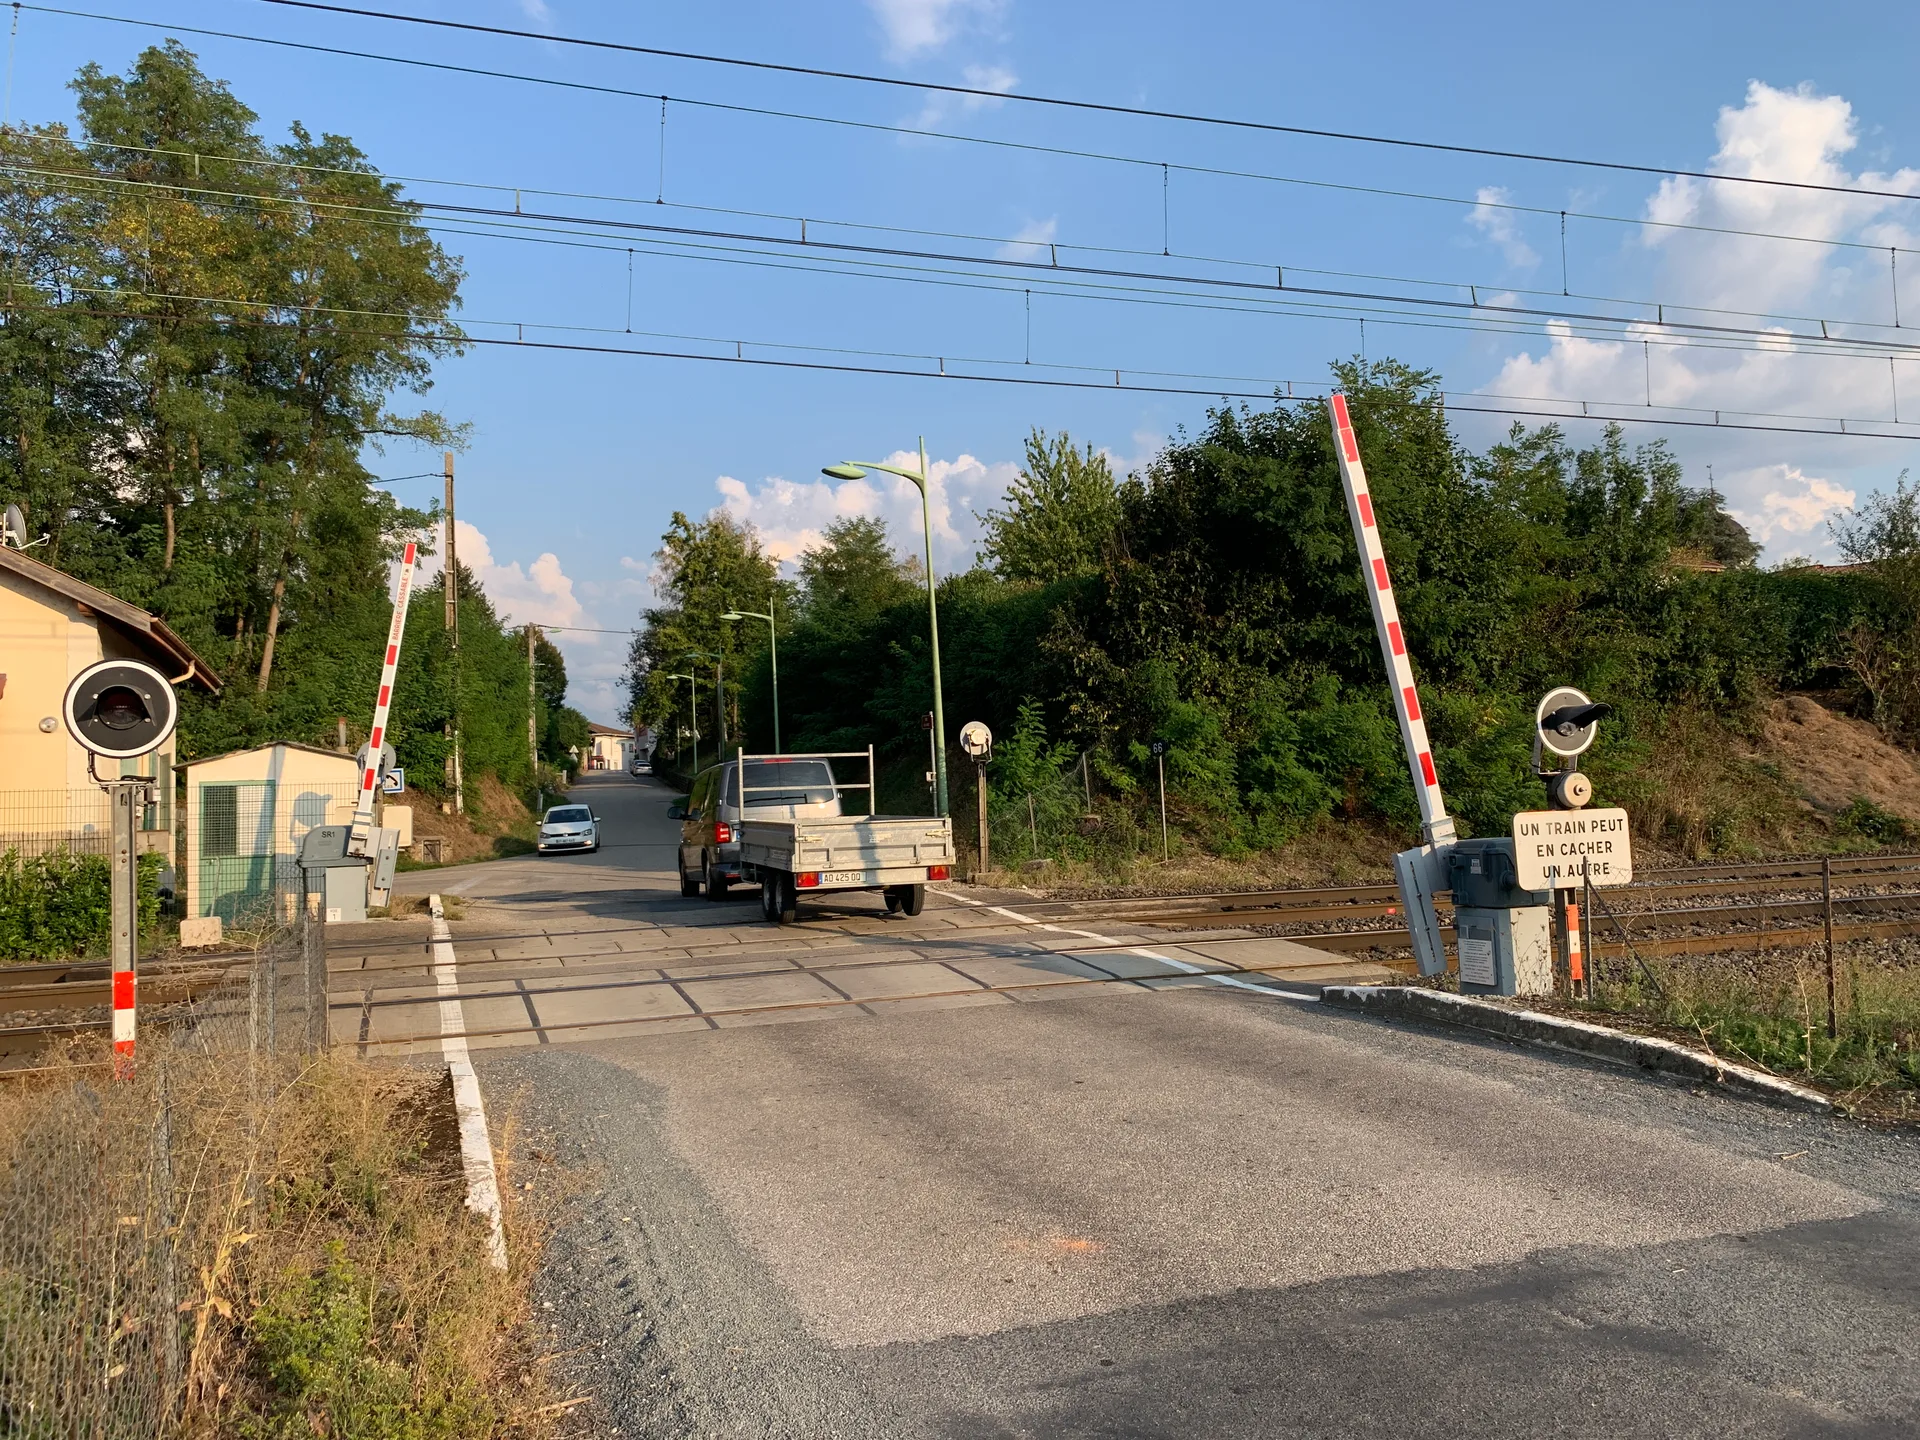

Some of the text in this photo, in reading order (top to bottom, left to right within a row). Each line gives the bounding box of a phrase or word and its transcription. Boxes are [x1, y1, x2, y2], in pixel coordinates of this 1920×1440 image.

[392, 577, 408, 640] BARRIERE CASSABLE
[1153, 742, 1163, 753] 66
[1520, 818, 1624, 836] UN TRAIN PEUT
[321, 831, 336, 839] SR1
[1537, 841, 1613, 857] EN CACHER
[835, 873, 850, 882] 425
